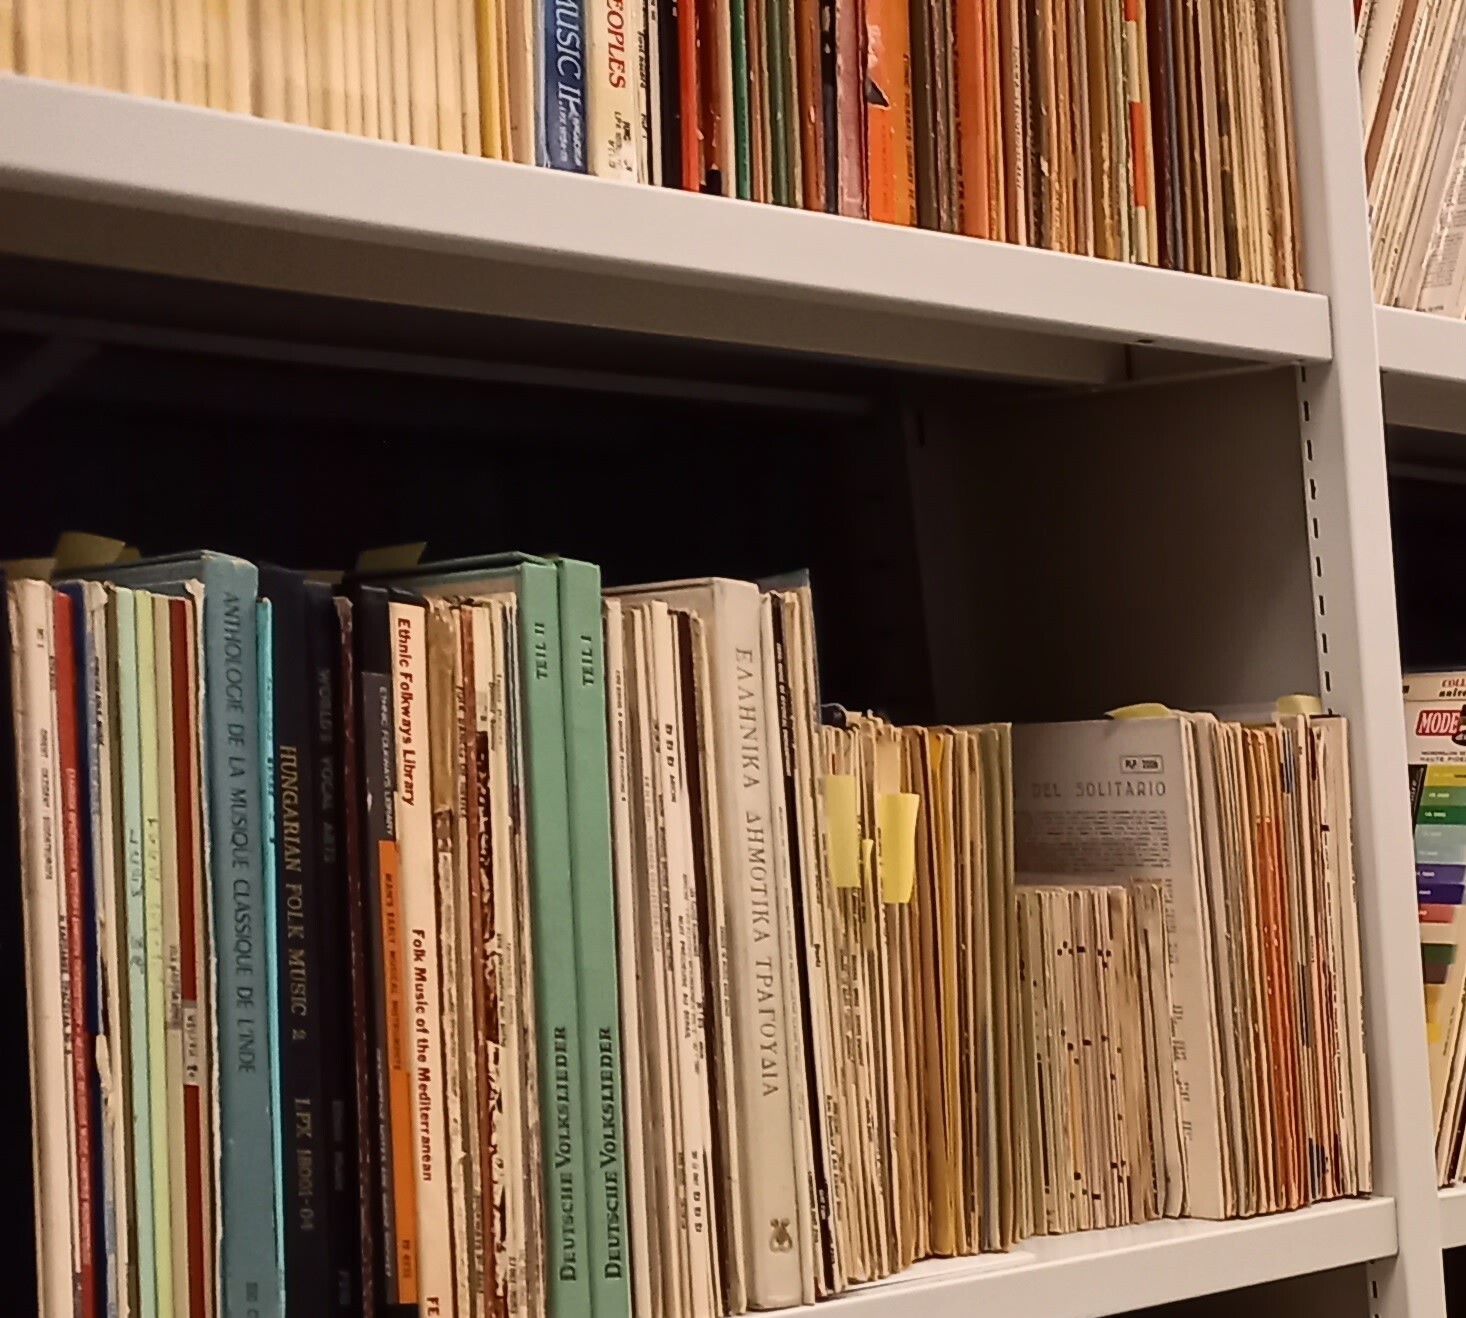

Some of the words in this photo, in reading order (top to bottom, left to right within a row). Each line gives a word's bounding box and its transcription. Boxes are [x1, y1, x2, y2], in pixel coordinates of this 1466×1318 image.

[223, 592, 243, 712] ANTHOLOGIE
[398, 618, 413, 667] Ethnic
[534, 622, 545, 635] II
[534, 642, 548, 680] TEIL
[580, 648, 594, 686] TEIL
[399, 672, 415, 744] Folkways
[734, 648, 760, 789] ΕΛΛΗΝΙΚΑ
[1417, 711, 1461, 734] MODE
[227, 724, 245, 746] DE
[380, 730, 392, 788] FOLKWAYS
[228, 755, 246, 778] LA
[401, 749, 416, 806] Library
[1031, 782, 1062, 798] DEL
[1075, 781, 1167, 798] SOLITARIO
[230, 788, 250, 868] MUSIQUE
[279, 745, 301, 872] HUNGARIAN
[383, 790, 394, 837] LIBRARY
[746, 811, 772, 943] ΔΗΜΟΤΙΚΑ
[233, 880, 254, 975] CLASSIQUE
[284, 884, 304, 938] FOLK
[386, 912, 397, 944] EARLY
[411, 929, 426, 961] Folk
[237, 987, 254, 1008] DE
[287, 949, 306, 1015] MUSIC
[413, 967, 429, 1014] Music
[238, 1019, 257, 1074] L'INDE
[292, 1029, 306, 1041] 2
[415, 1018, 431, 1034] of
[417, 1038, 430, 1063] the
[755, 957, 779, 1097] ΤΡΑΓΟΥΔΙΑ
[295, 1098, 311, 1138] LPX
[553, 1027, 572, 1169] VOLKSLIEDER
[598, 1027, 617, 1168] VOLKSLIEDER
[418, 1067, 434, 1181] Mediterranean
[557, 1171, 576, 1281] DEUTSCHE
[602, 1171, 622, 1279] DEUTSCHE
[426, 1296, 439, 1316] FE
